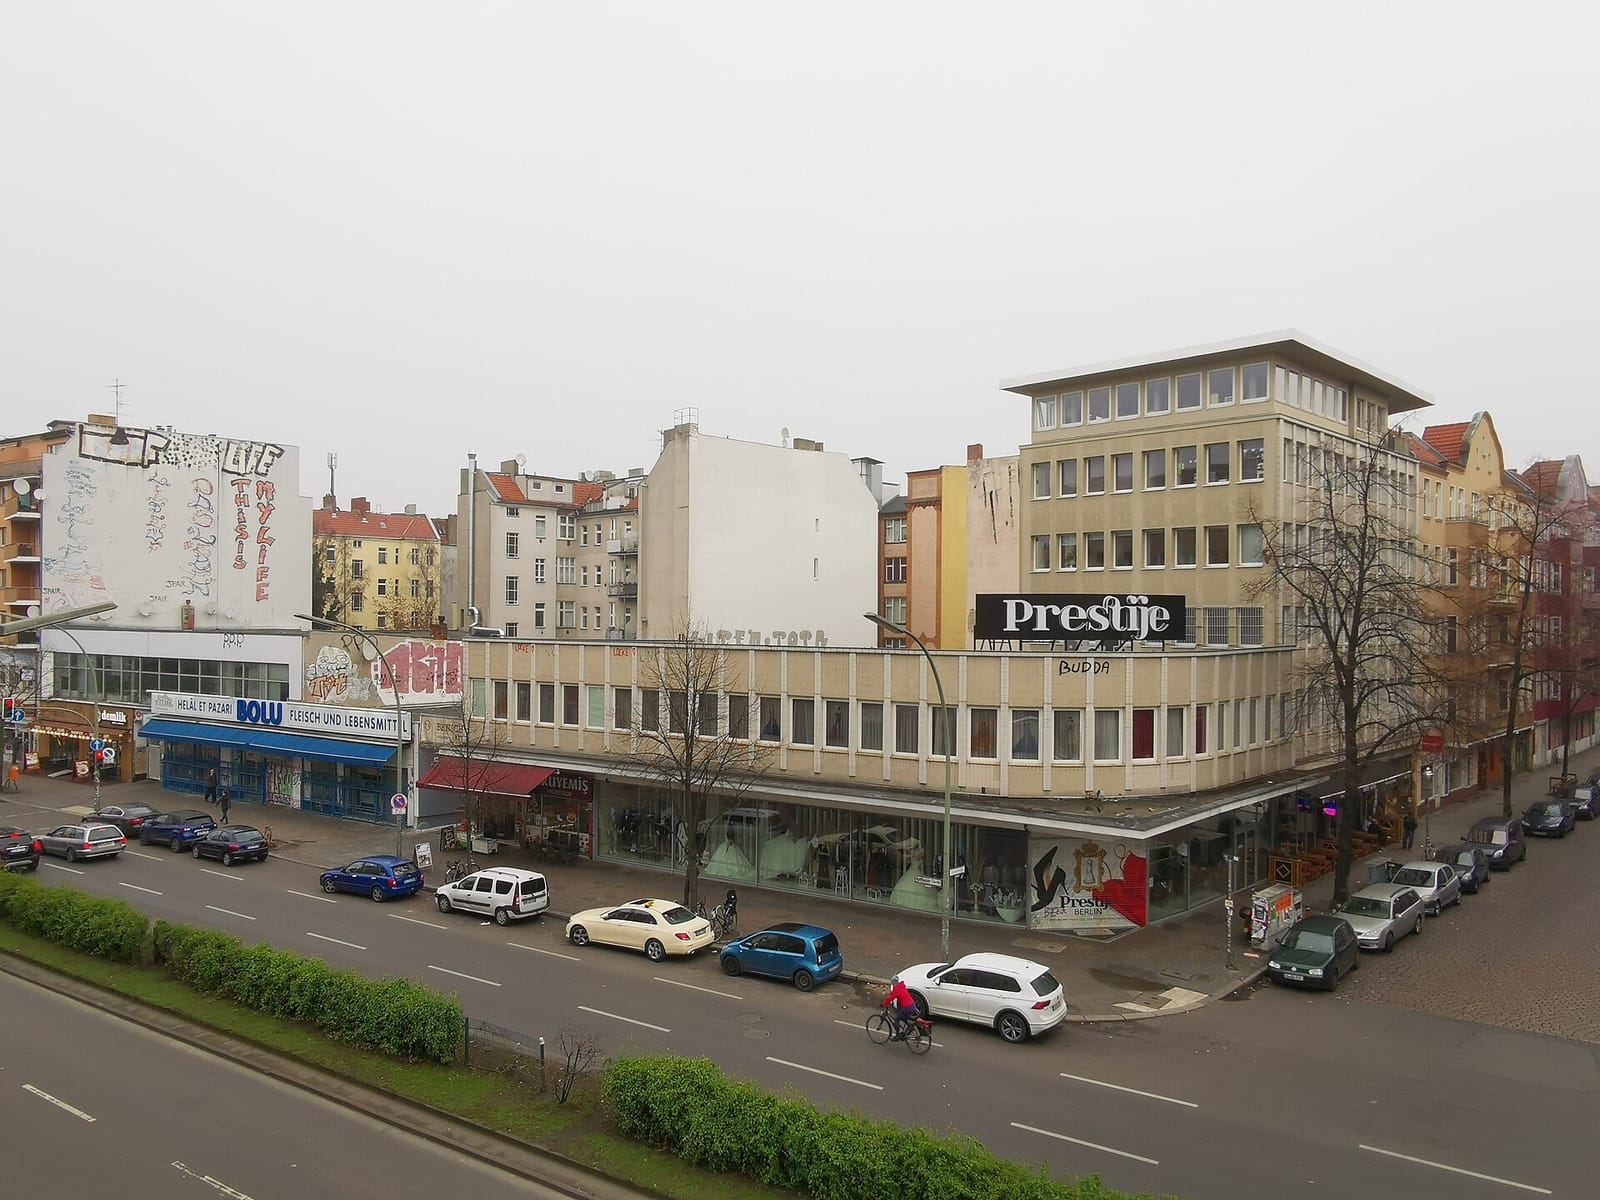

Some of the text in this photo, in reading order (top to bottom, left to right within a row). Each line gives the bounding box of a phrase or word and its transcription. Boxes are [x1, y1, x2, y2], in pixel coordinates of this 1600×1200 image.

[1002, 595, 1170, 640] Prestije
[1058, 660, 1110, 676] BUDDA
[199, 701, 206, 712] ET
[208, 702, 232, 715] PAZARI
[236, 699, 283, 726] BOLU
[290, 710, 407, 733] FLEISCH UND LEBENSMITTL
[1074, 907, 1103, 916] BERLIN
